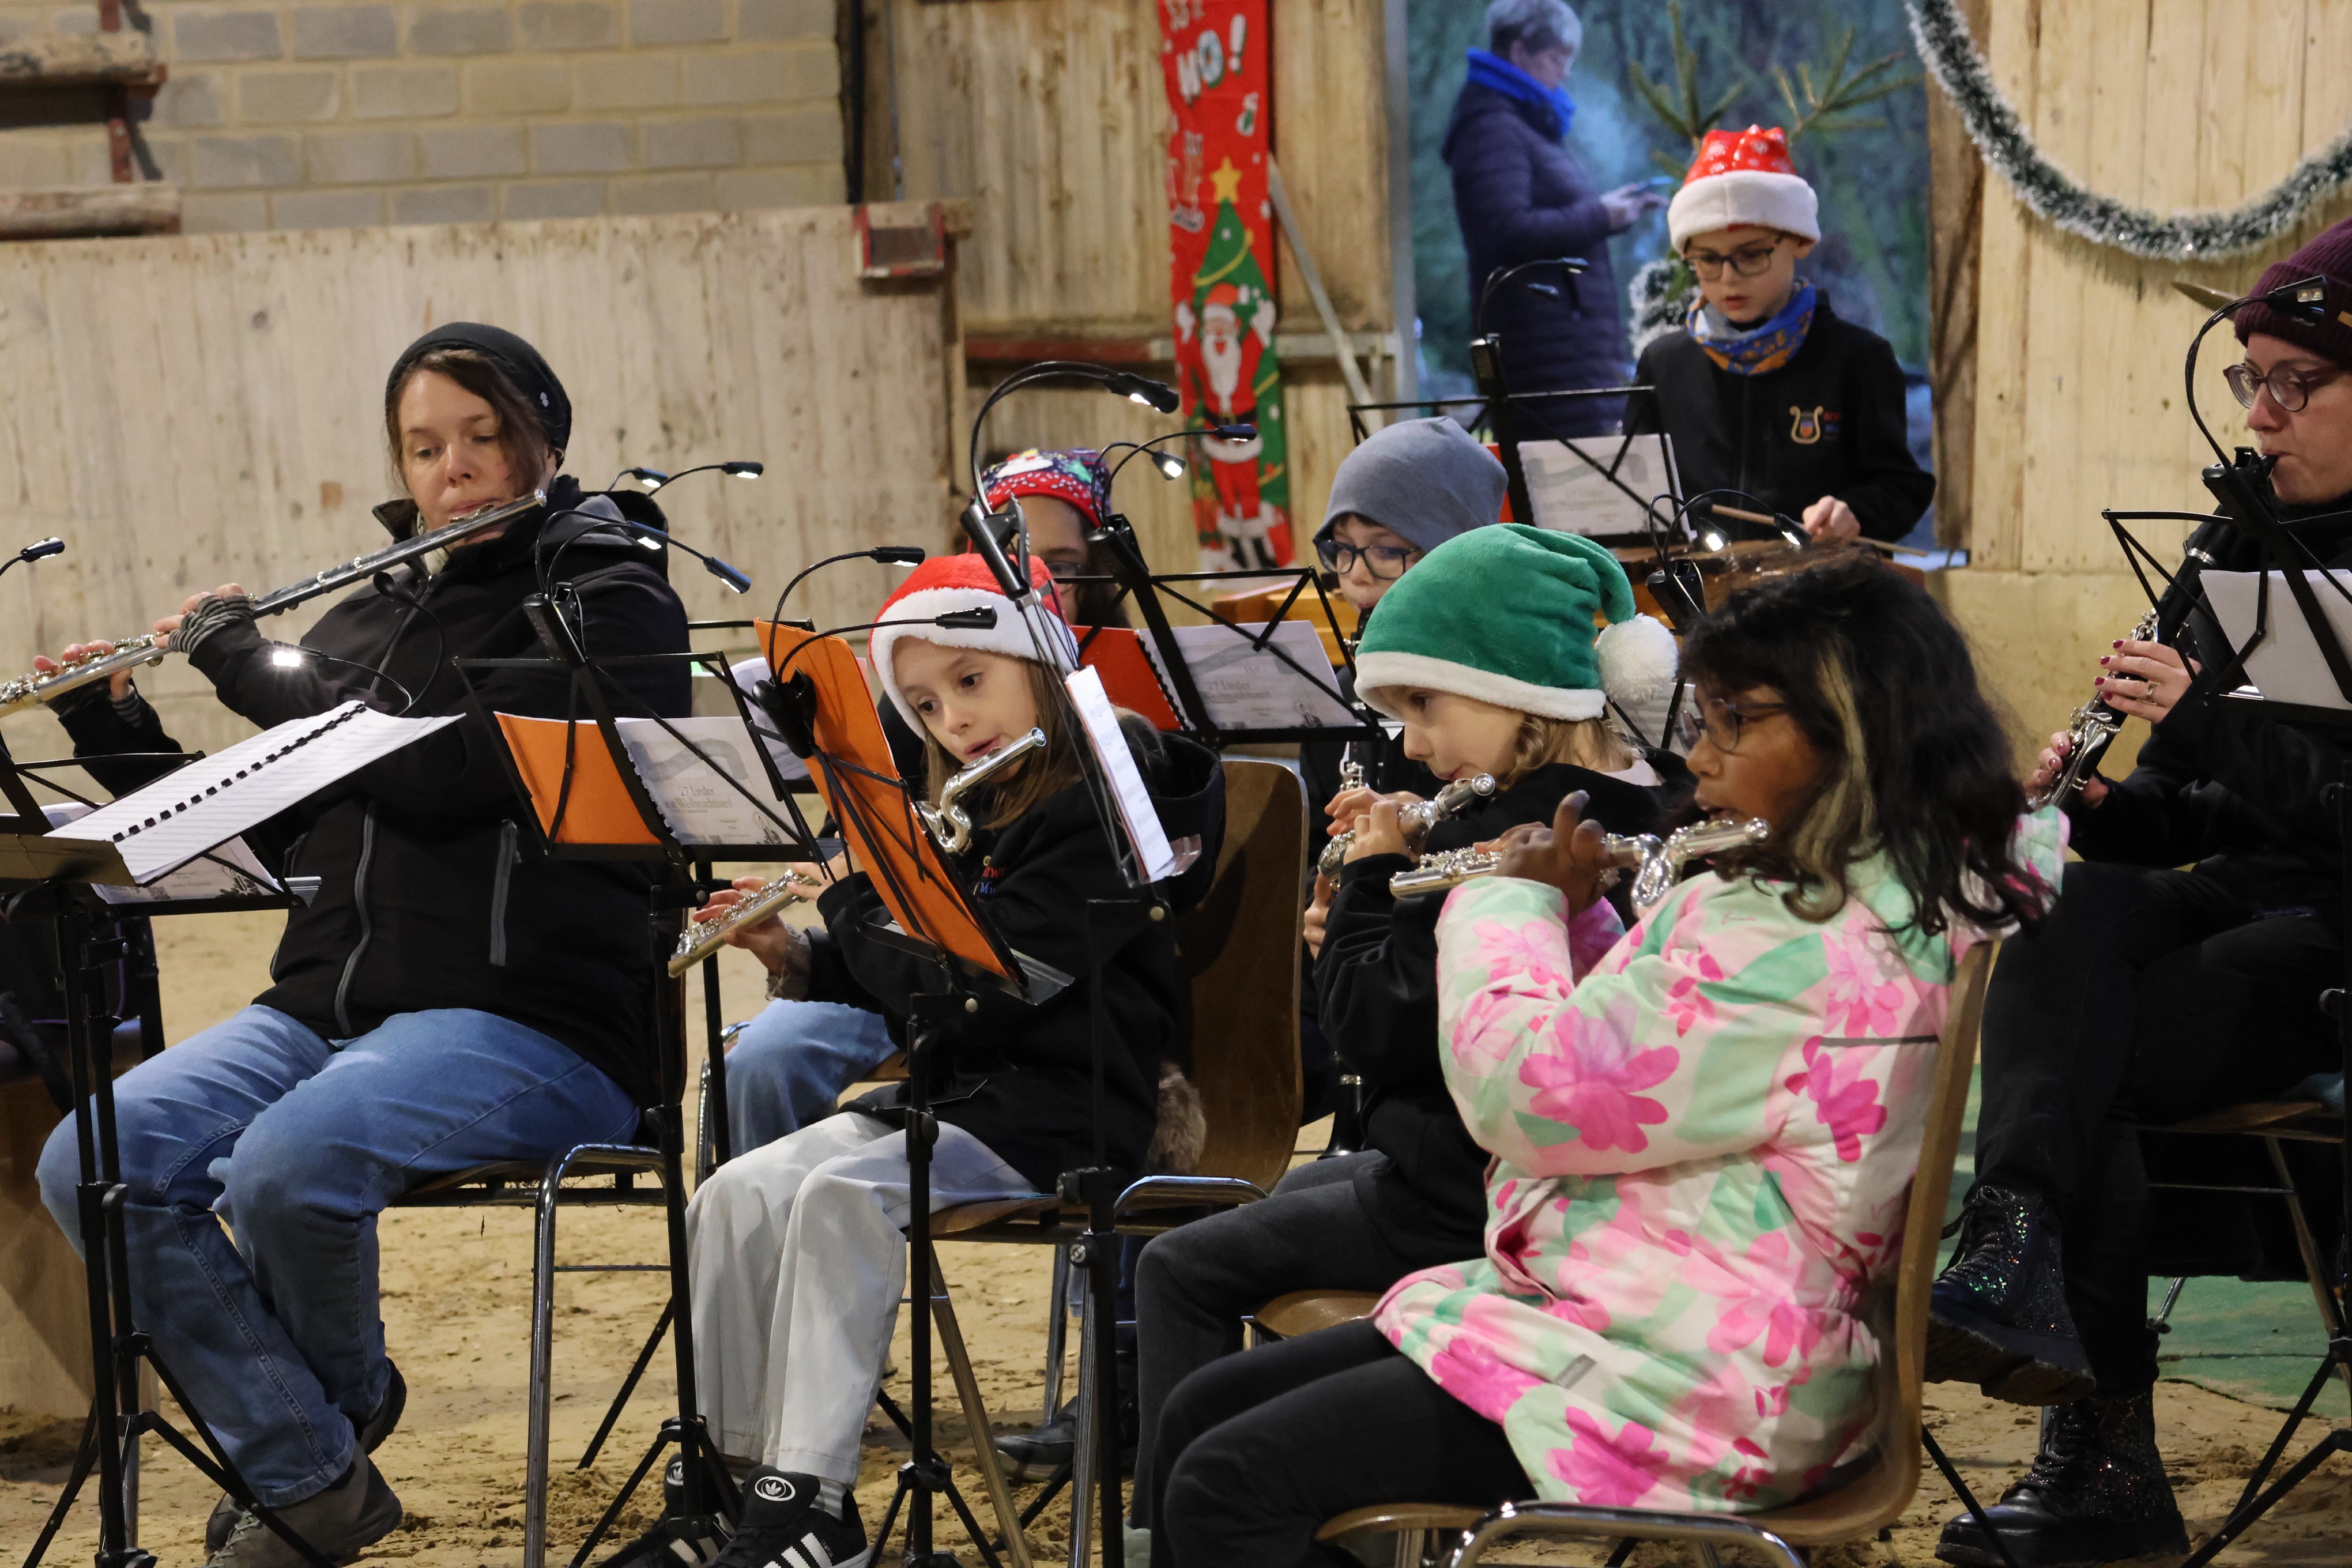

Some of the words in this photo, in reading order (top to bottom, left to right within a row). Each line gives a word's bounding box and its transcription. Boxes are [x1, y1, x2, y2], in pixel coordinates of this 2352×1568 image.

[1176, 13, 1247, 106] HO!
[689, 785, 715, 797] Lieder
[675, 798, 734, 809] Weihnachtszeit
